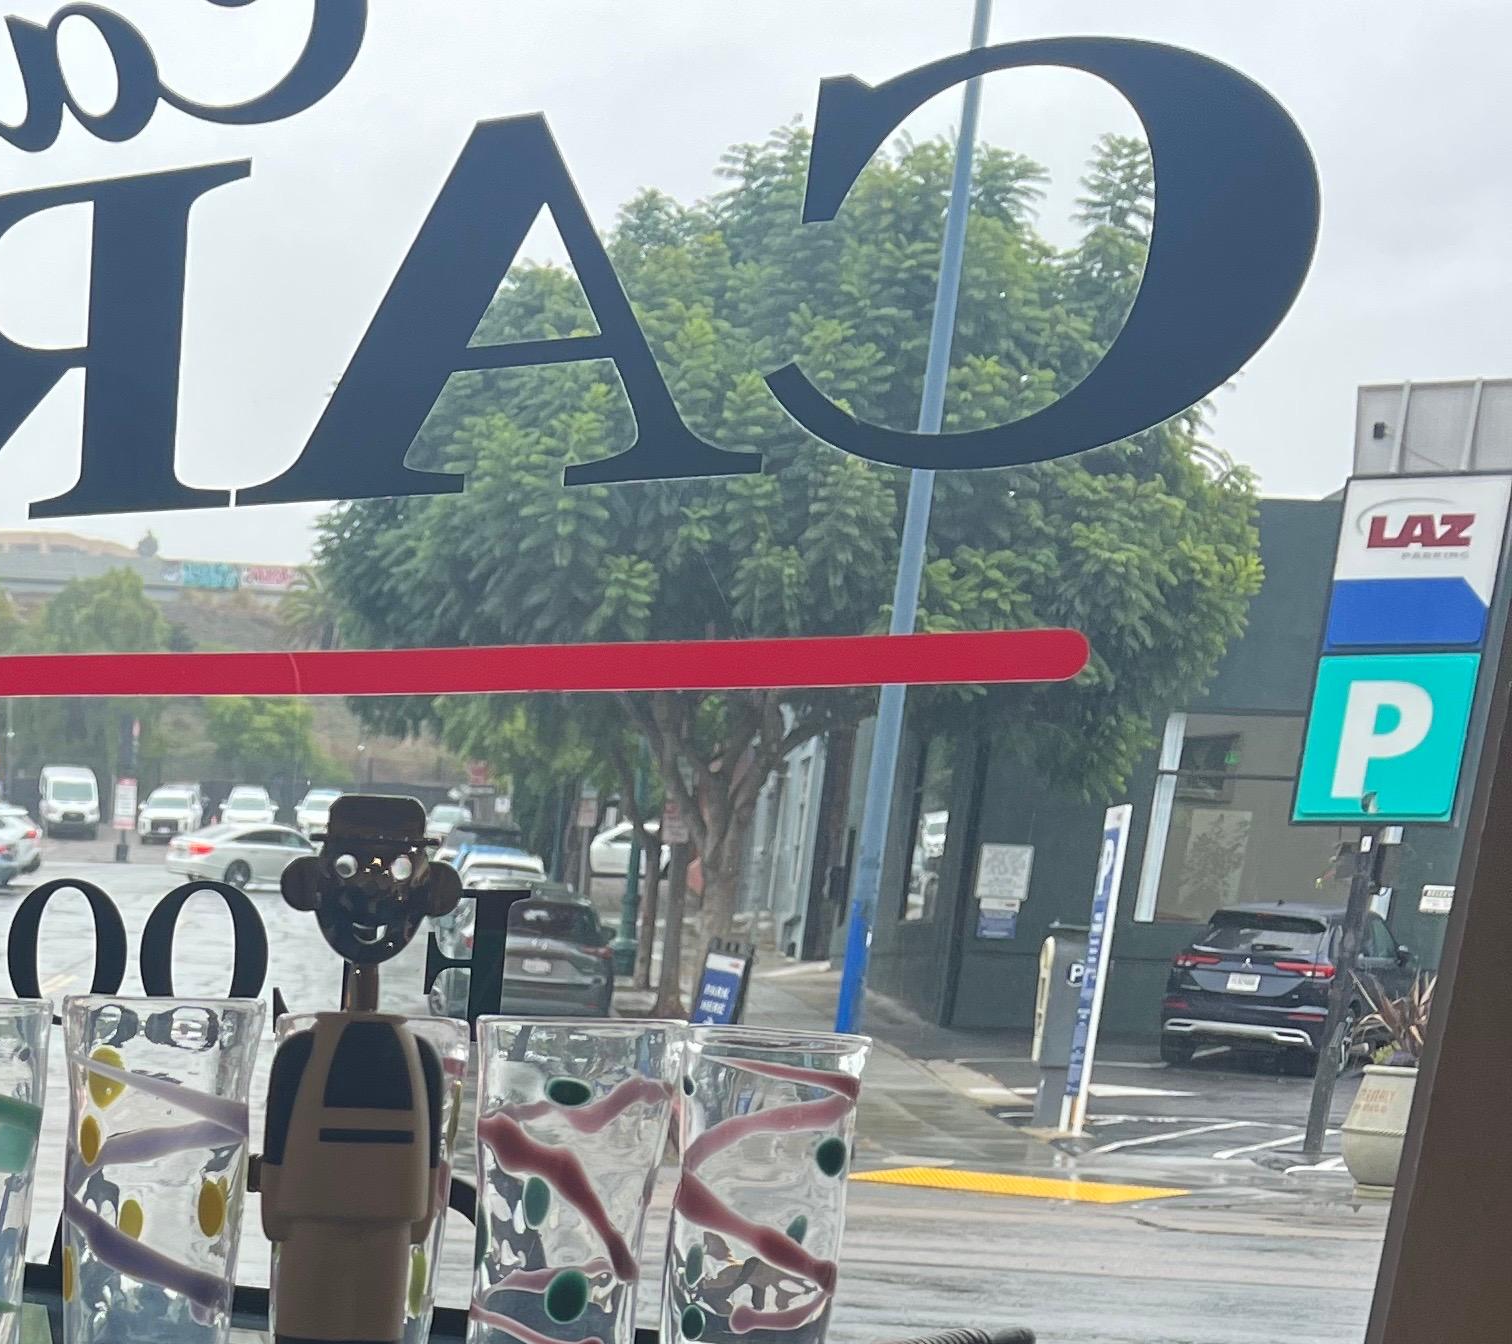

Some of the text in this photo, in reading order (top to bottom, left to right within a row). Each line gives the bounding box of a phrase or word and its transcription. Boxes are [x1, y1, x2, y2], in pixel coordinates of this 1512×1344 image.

[1367, 513, 1476, 548] LAZ
[1401, 551, 1470, 561] PARKING
[1331, 679, 1434, 799] P
